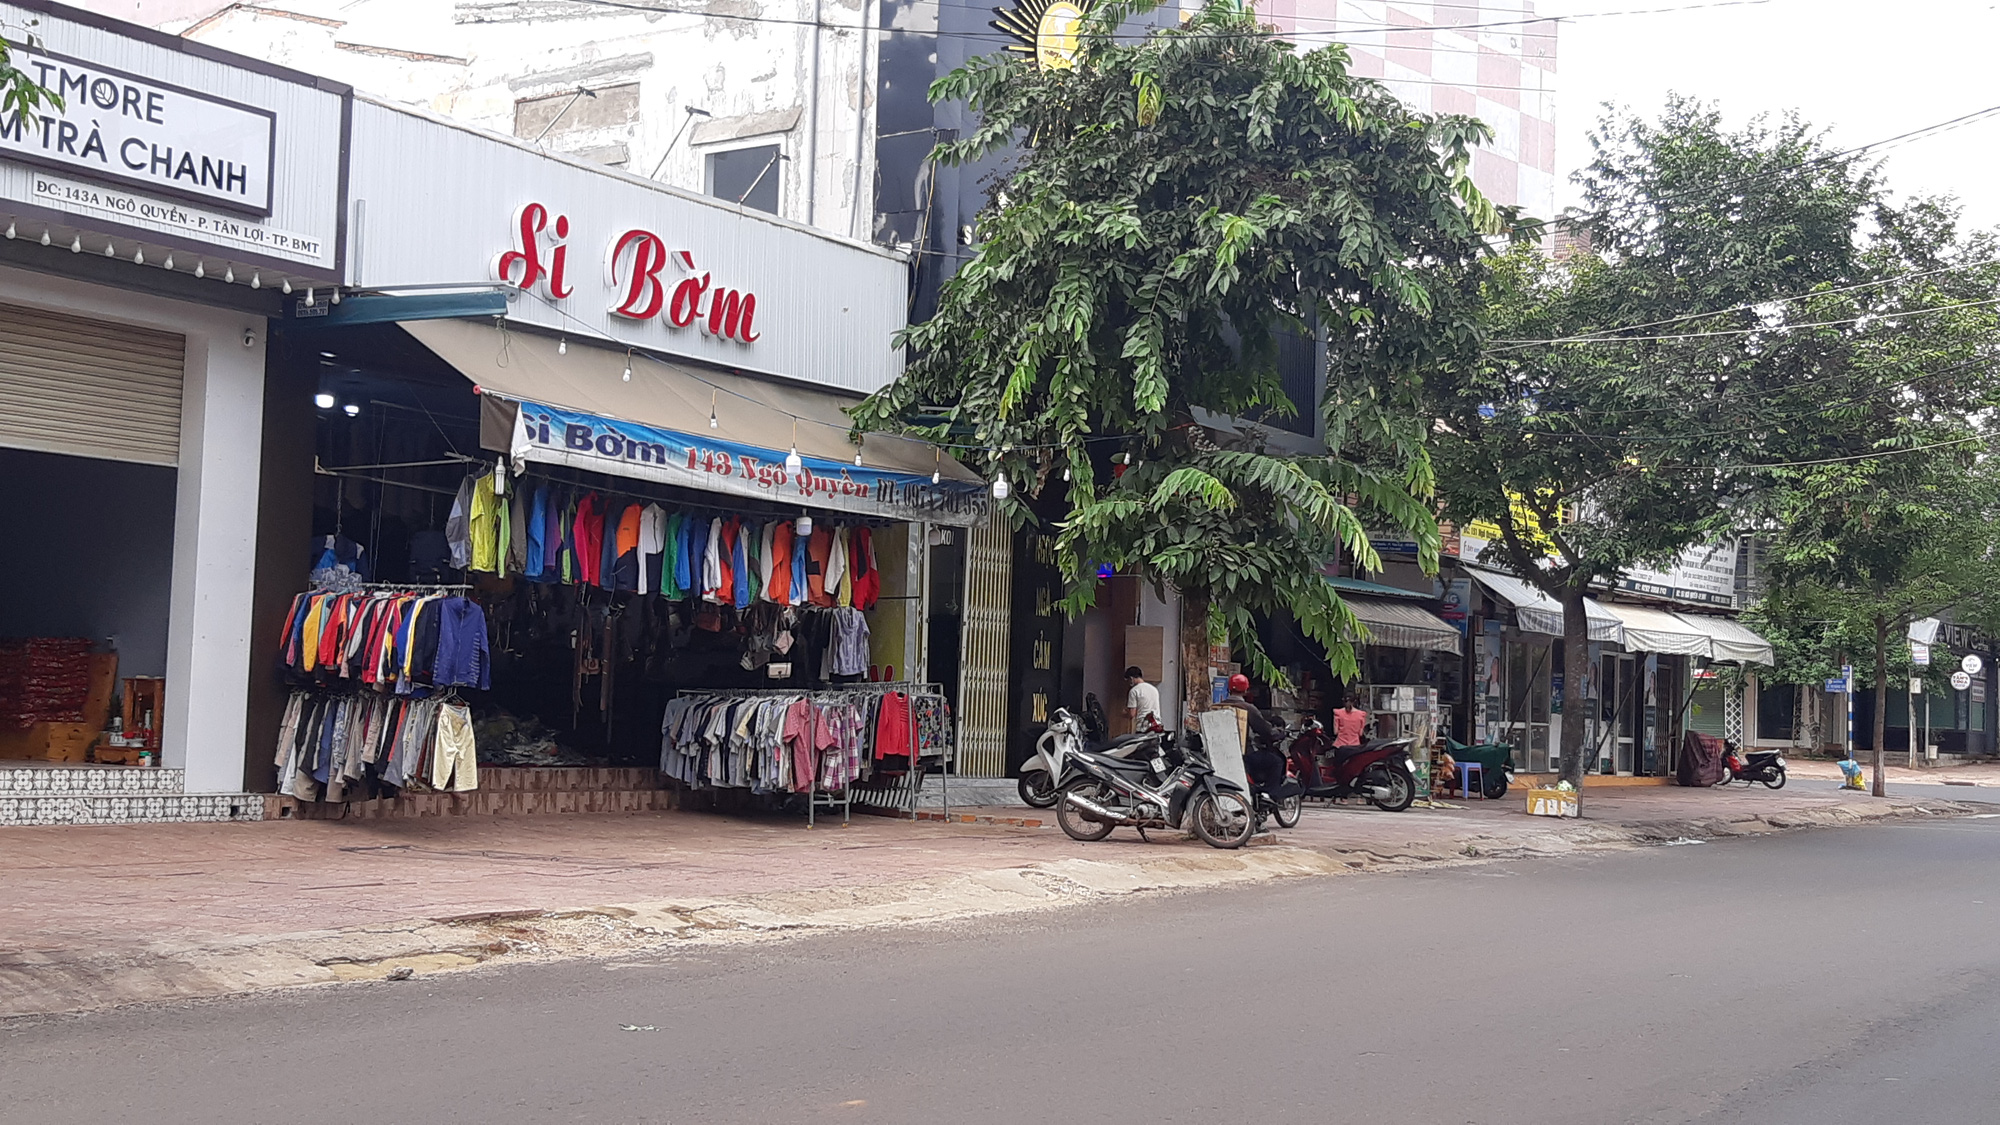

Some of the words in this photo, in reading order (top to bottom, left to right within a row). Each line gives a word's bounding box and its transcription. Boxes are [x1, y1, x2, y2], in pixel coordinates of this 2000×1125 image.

[39, 114, 108, 164] TRÀ
[120, 137, 247, 195] CHANH
[36, 180, 62, 198] ĐC:
[65, 186, 101, 205] 143A
[106, 196, 136, 213] NGÔ
[140, 203, 188, 225] QUYỀN
[198, 217, 209, 229] P.
[213, 219, 240, 236] TÂN
[244, 227, 264, 242] LỢI
[272, 233, 289, 248] TP.
[292, 238, 320, 254] BMT
[496, 202, 574, 299] Si
[607, 229, 761, 343] Bờm
[565, 421, 667, 465] Bờm
[684, 446, 734, 476] 143
[739, 456, 788, 489] Ngô
[794, 467, 870, 499] Quyền
[1032, 630, 1051, 670] CẢM
[1943, 623, 1969, 649] VIEW
[1031, 687, 1048, 723] XÚC
